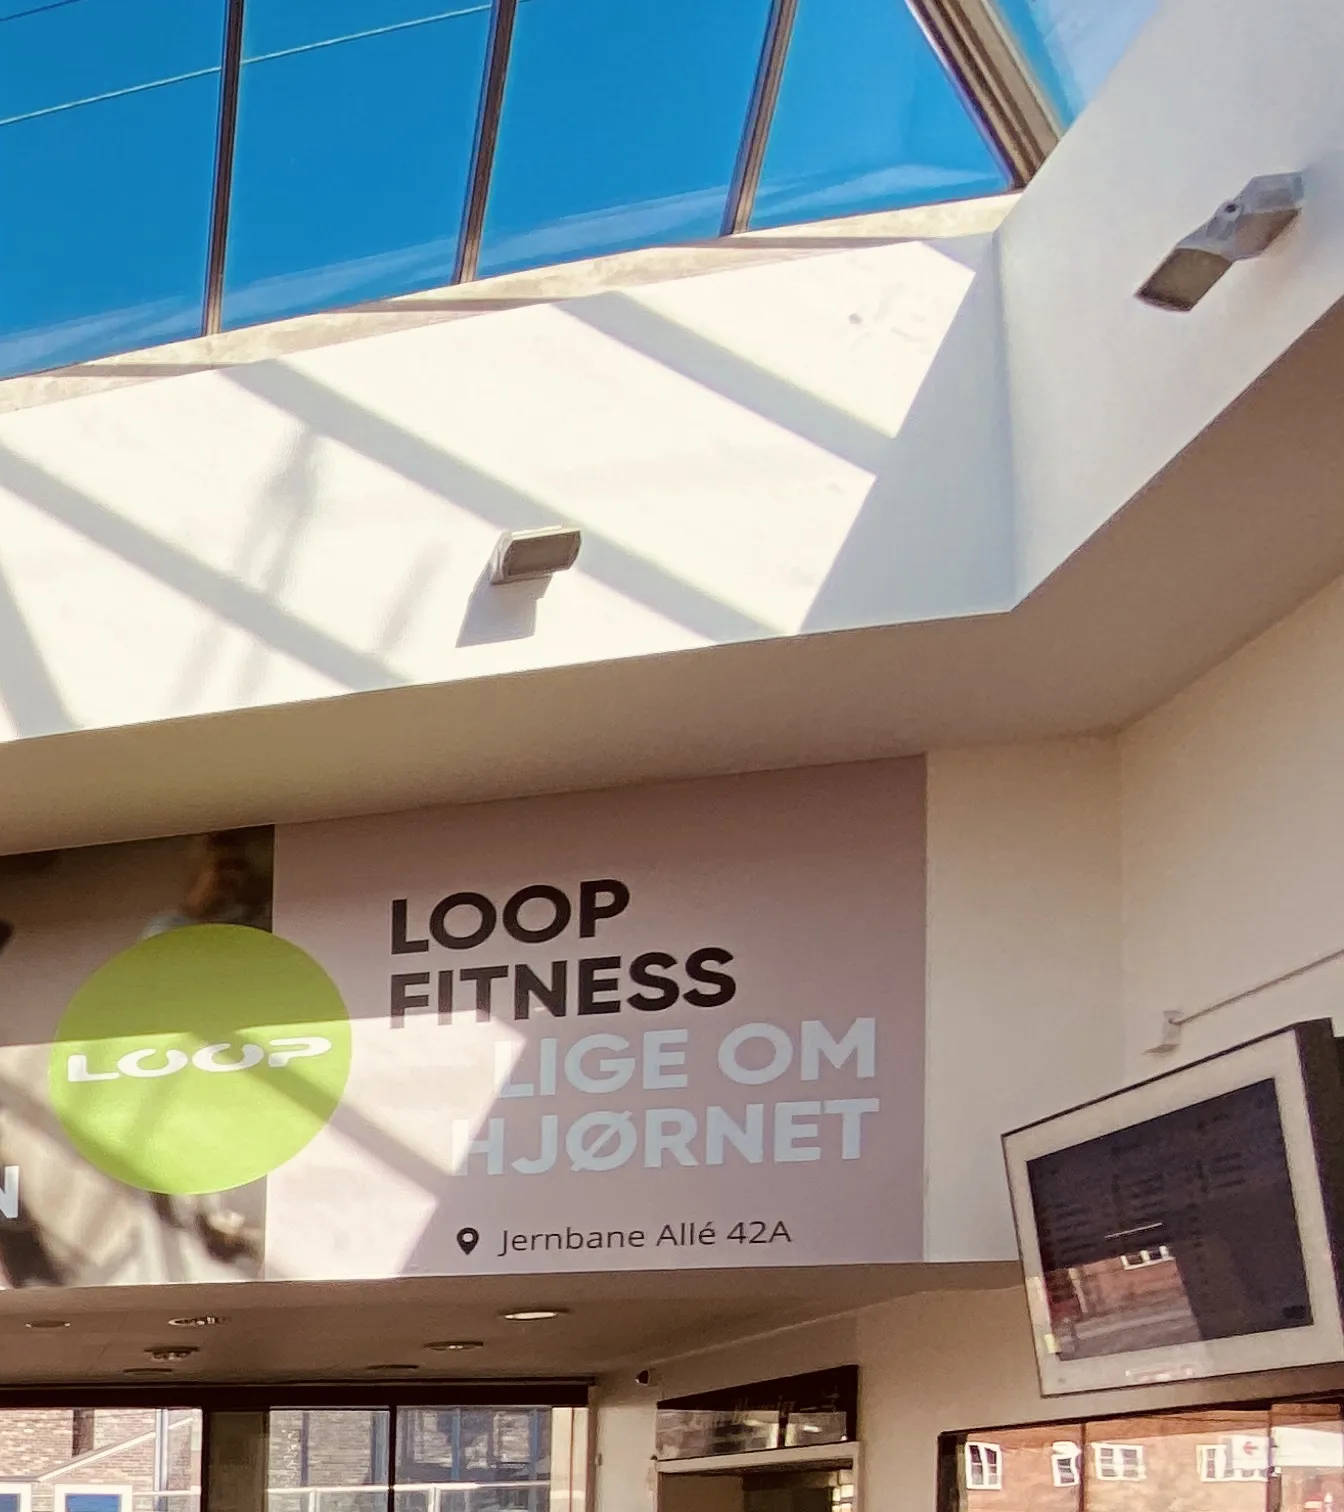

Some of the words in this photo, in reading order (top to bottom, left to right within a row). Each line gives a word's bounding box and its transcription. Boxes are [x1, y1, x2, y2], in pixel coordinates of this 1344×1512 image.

[391, 879, 631, 955] LOOP
[389, 947, 737, 1030] FITNESS
[68, 1036, 332, 1083] LOOP
[492, 1029, 689, 1099] LIGE
[718, 1017, 876, 1086] OM
[451, 1098, 880, 1177] HJØRNET
[497, 1227, 646, 1258] Jernbane
[656, 1221, 716, 1248] Allé
[727, 1219, 793, 1245] 42A
